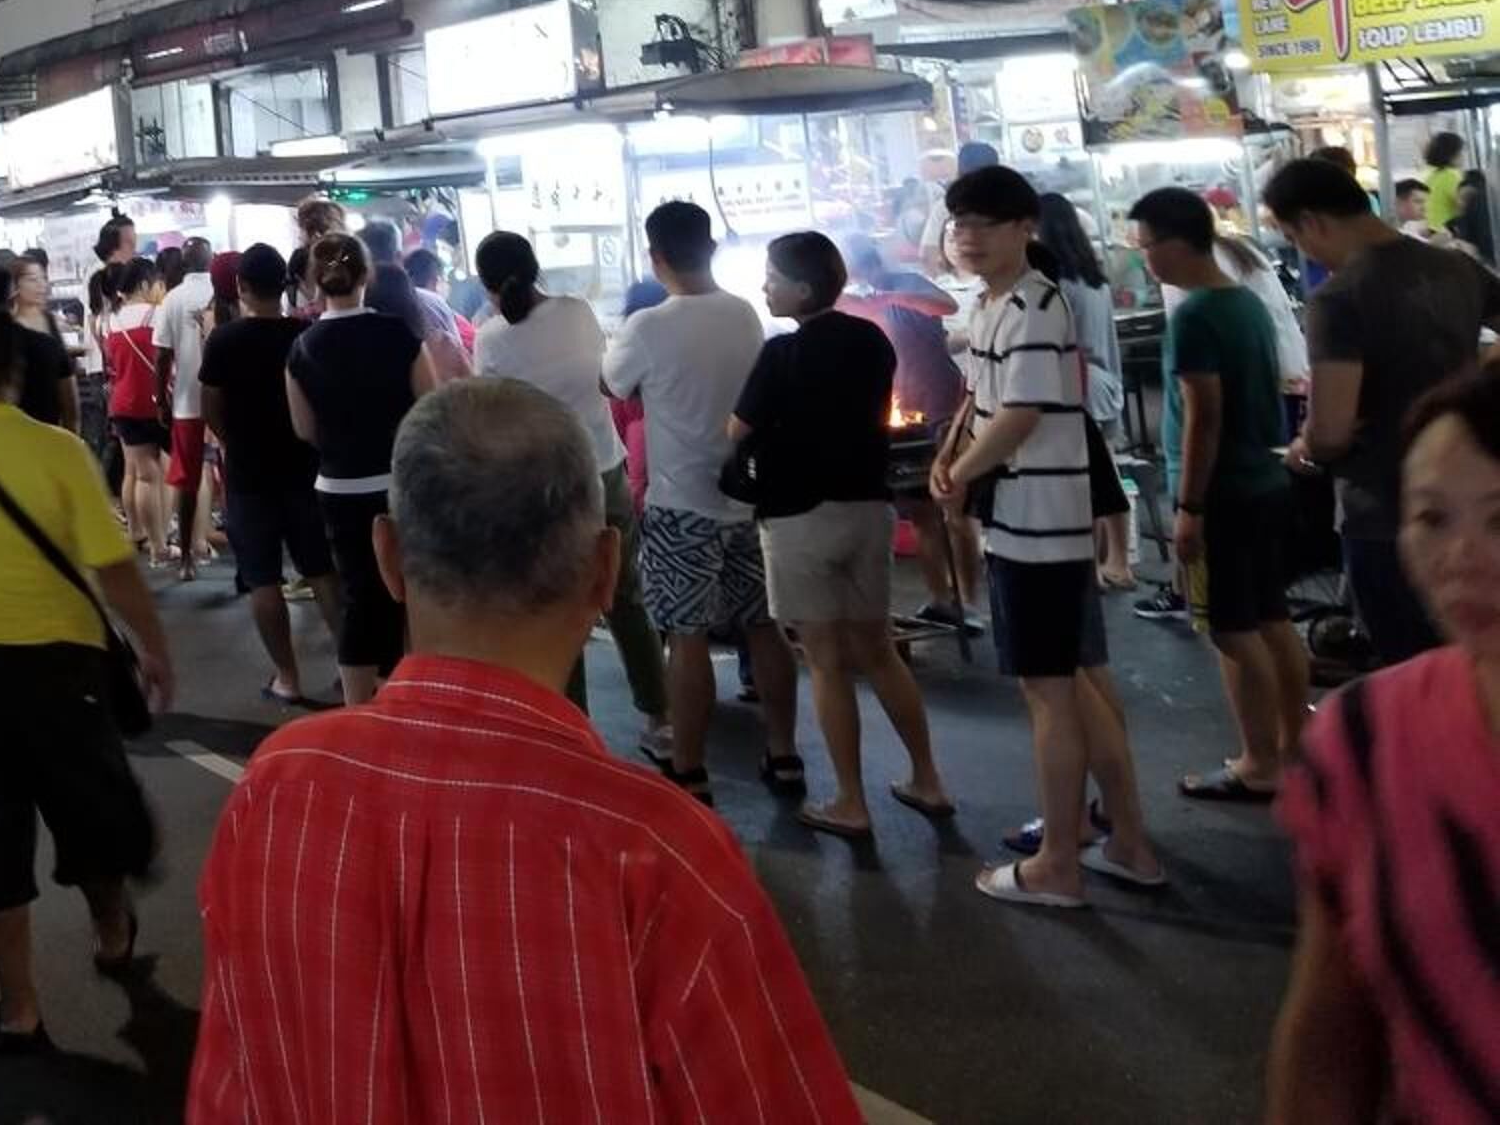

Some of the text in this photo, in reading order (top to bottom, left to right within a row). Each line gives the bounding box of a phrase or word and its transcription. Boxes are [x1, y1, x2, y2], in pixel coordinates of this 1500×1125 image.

[1357, 15, 1484, 50] SOUP LEMBU
[1258, 41, 1291, 59] SINCE
